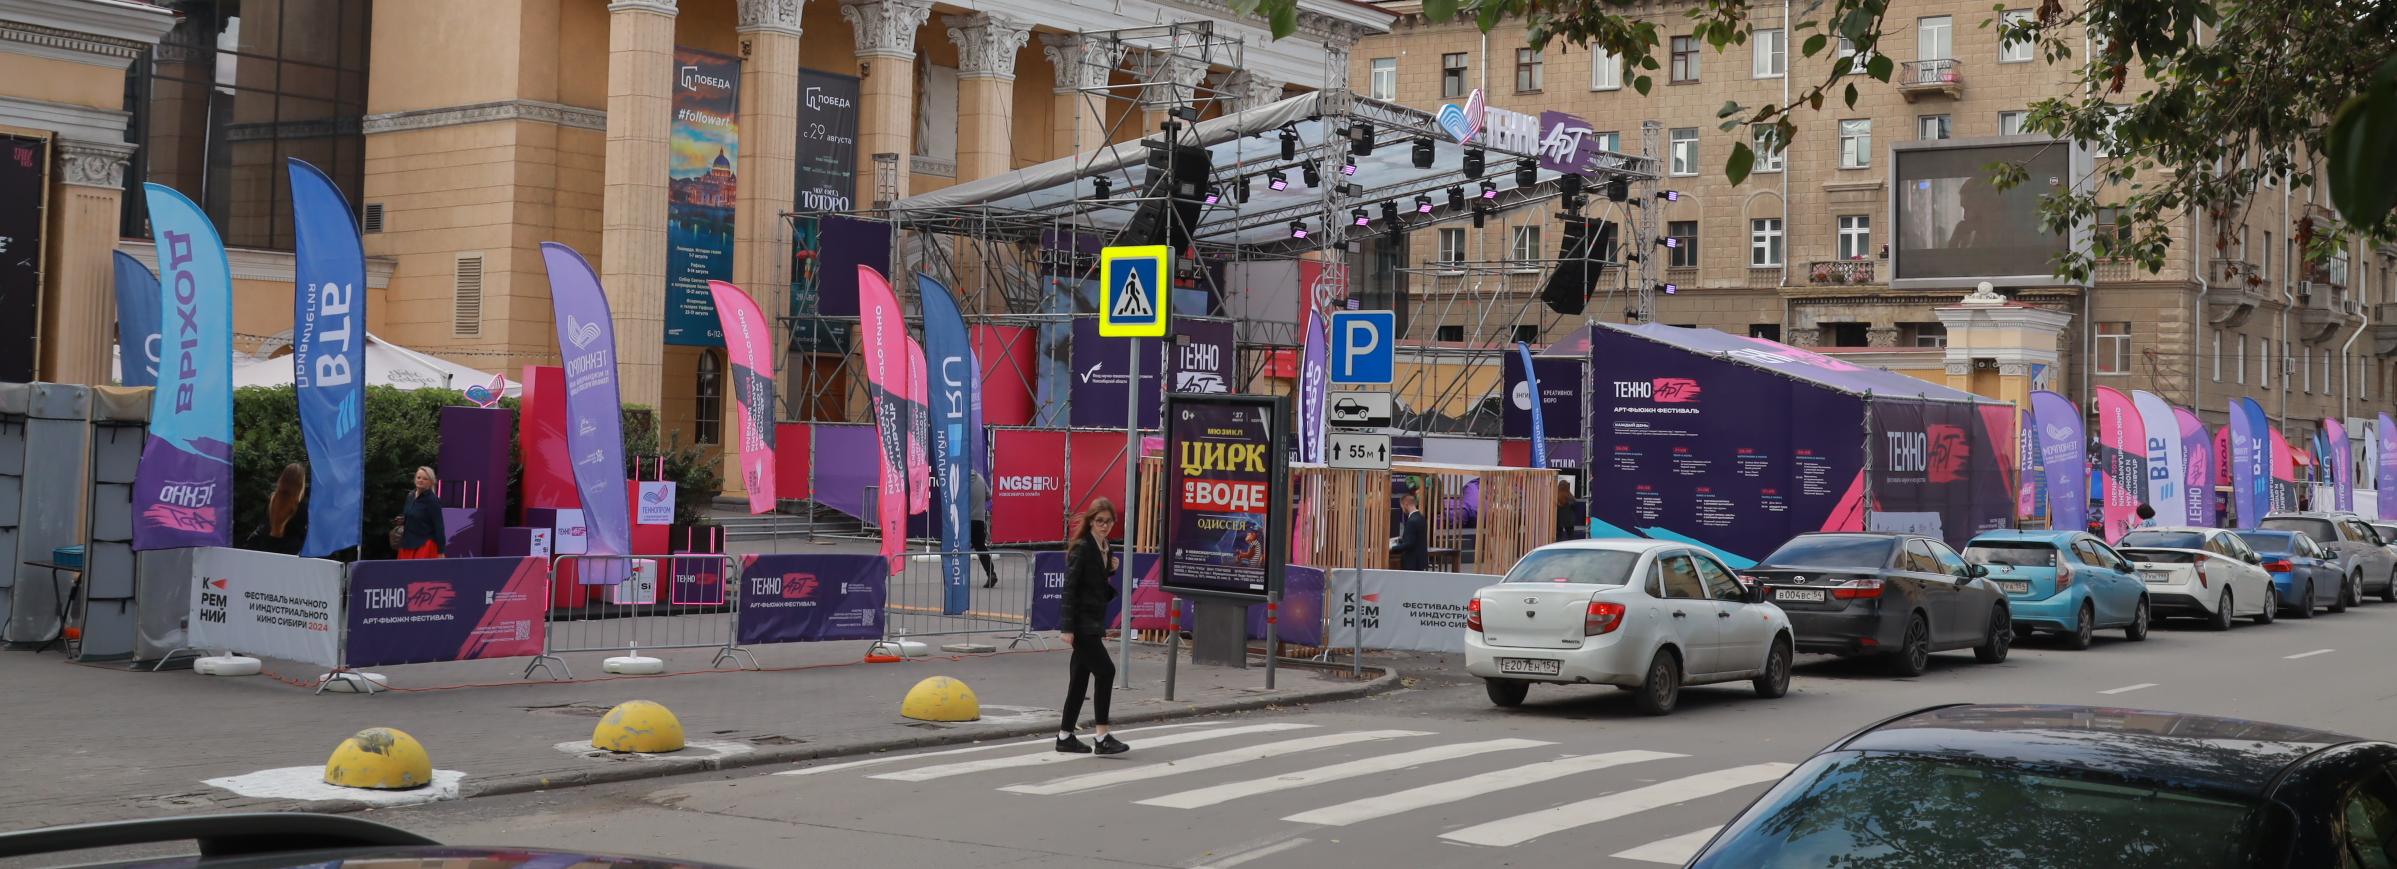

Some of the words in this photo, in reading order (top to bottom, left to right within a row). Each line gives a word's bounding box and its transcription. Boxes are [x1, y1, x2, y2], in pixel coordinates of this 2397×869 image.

[694, 74, 730, 89] ПОБЕДА
[818, 94, 851, 108] ПОБЕДА
[678, 108, 730, 127] #followart
[810, 122, 826, 141] 29
[826, 135, 852, 145] августа
[1484, 106, 1540, 157] ТЕХНО
[1539, 122, 1593, 165] АРТ
[801, 190, 849, 212] ТОТОРО
[1345, 320, 1379, 376] P
[1180, 344, 1219, 371] ТЕХНО
[1613, 381, 1651, 398] ТЕХНО
[1654, 382, 1691, 399] АРТ
[1182, 409, 1195, 421] 0+
[1207, 428, 1244, 436] МЮЗИКЛ
[1180, 441, 1266, 477] ЦИРК
[1349, 444, 1366, 459] 55
[1887, 431, 1927, 472] ТЕХНО
[999, 475, 1033, 491] NGS
[1042, 476, 1059, 491] RU
[1196, 482, 1265, 512] ВОДЕ
[642, 506, 671, 514] ТЕХНОПРОМ
[1197, 518, 1247, 532] ОДИССЕЯ
[676, 574, 696, 583] ТЕХНО
[751, 577, 782, 595] ТЕХНО
[1043, 572, 1065, 588] ТЕХ
[201, 593, 227, 608] РЕМ
[244, 591, 288, 604] ФЕСТИВАЛЬ
[289, 596, 328, 610] НАУЧНОГО
[363, 588, 405, 609] ТЕХНО
[408, 585, 447, 606] АРТ
[1344, 592, 1355, 603] К
[200, 606, 226, 624] НИЙ
[249, 603, 255, 611] И
[256, 603, 329, 621] ИНДУСТРИАЛЬНОГО
[1402, 602, 1461, 611] ФЕСТИВАЛЬ
[256, 614, 277, 625] КИНО
[278, 616, 308, 629] СИБИРИ
[308, 621, 329, 632] 2024
[363, 616, 410, 625] АРТ-ФЬЮЖН
[410, 614, 455, 623] ФЕСТИВАЛЬ
[1418, 611, 1469, 620] ИНДУСТРИ
[1448, 621, 1467, 629] СИБ
